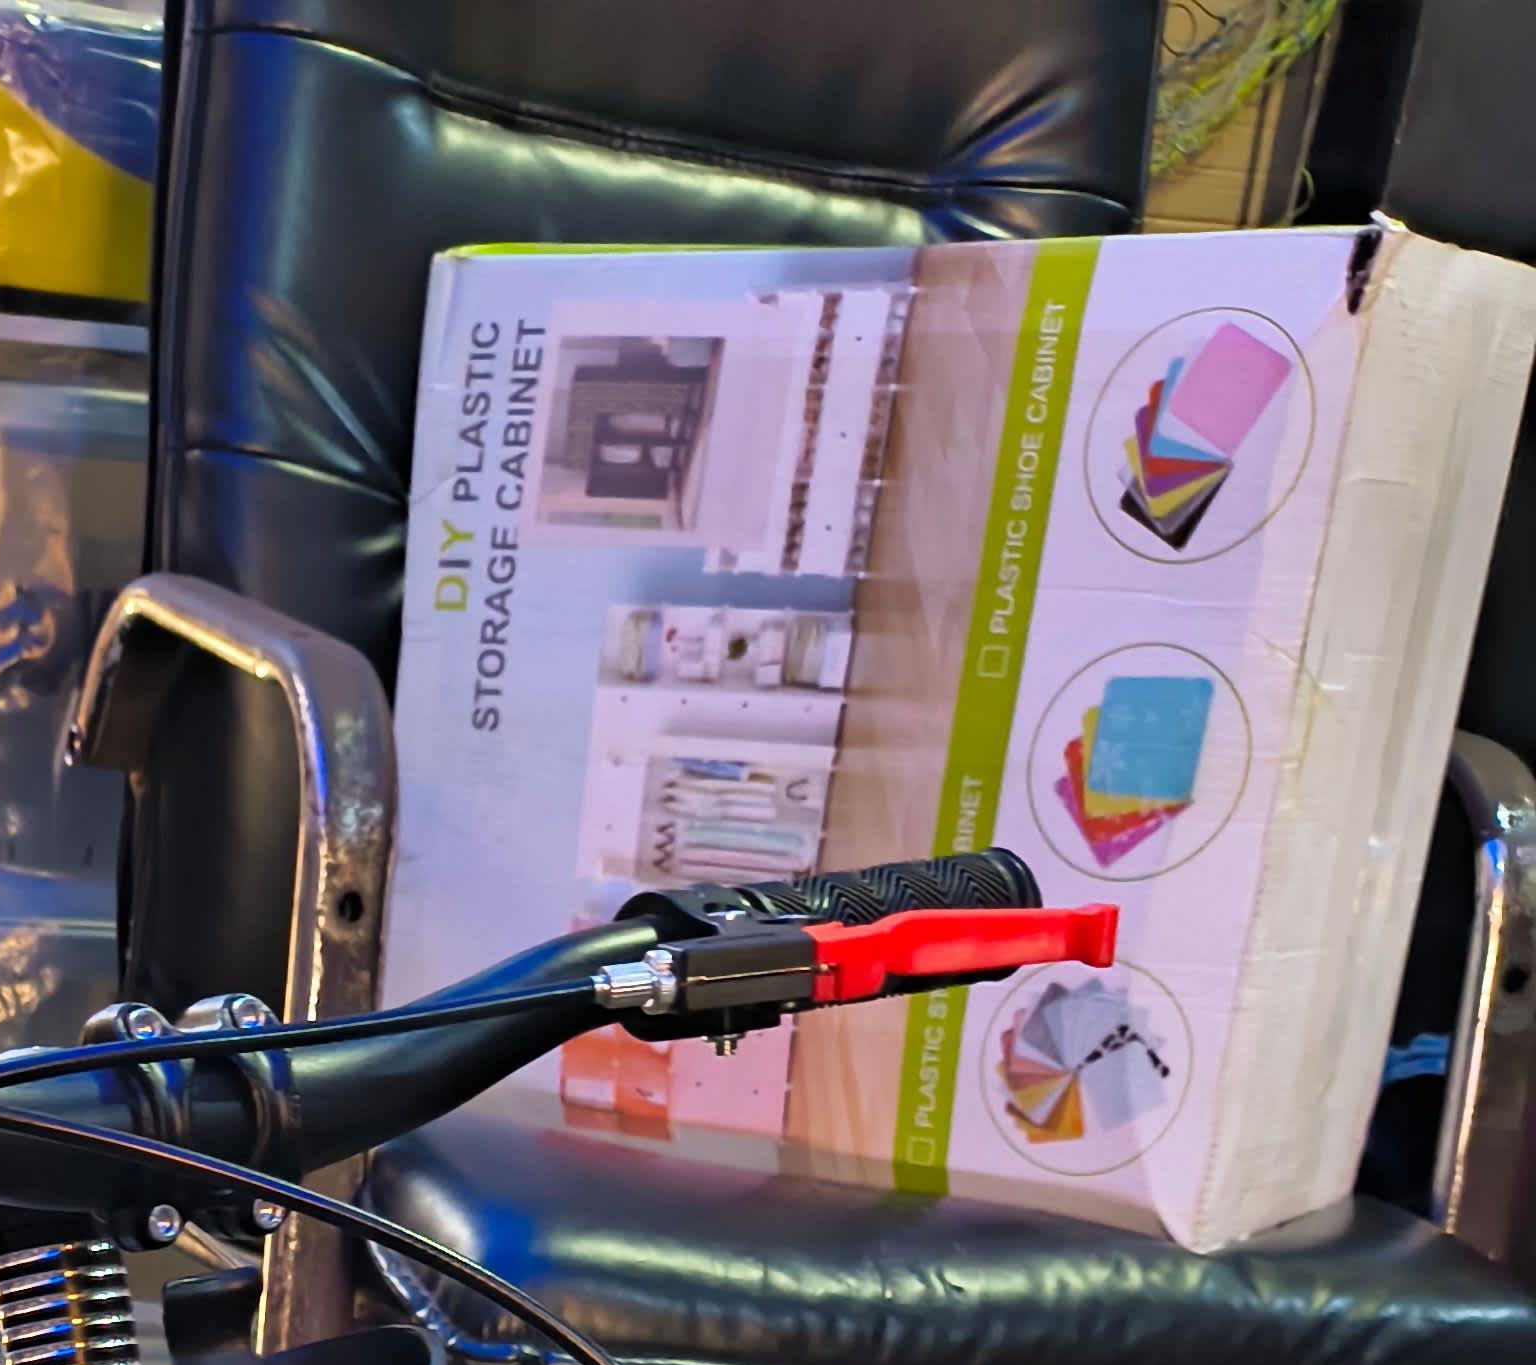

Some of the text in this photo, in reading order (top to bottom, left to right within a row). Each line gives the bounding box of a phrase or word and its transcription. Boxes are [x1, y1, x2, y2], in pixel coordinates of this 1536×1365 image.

[434, 320, 501, 611] DIY PLASTIC
[471, 318, 547, 732] STORAGE CABINET
[989, 298, 1067, 635] PLASTIC SHOE CABINET
[914, 1026, 946, 1128] PLASTIC
